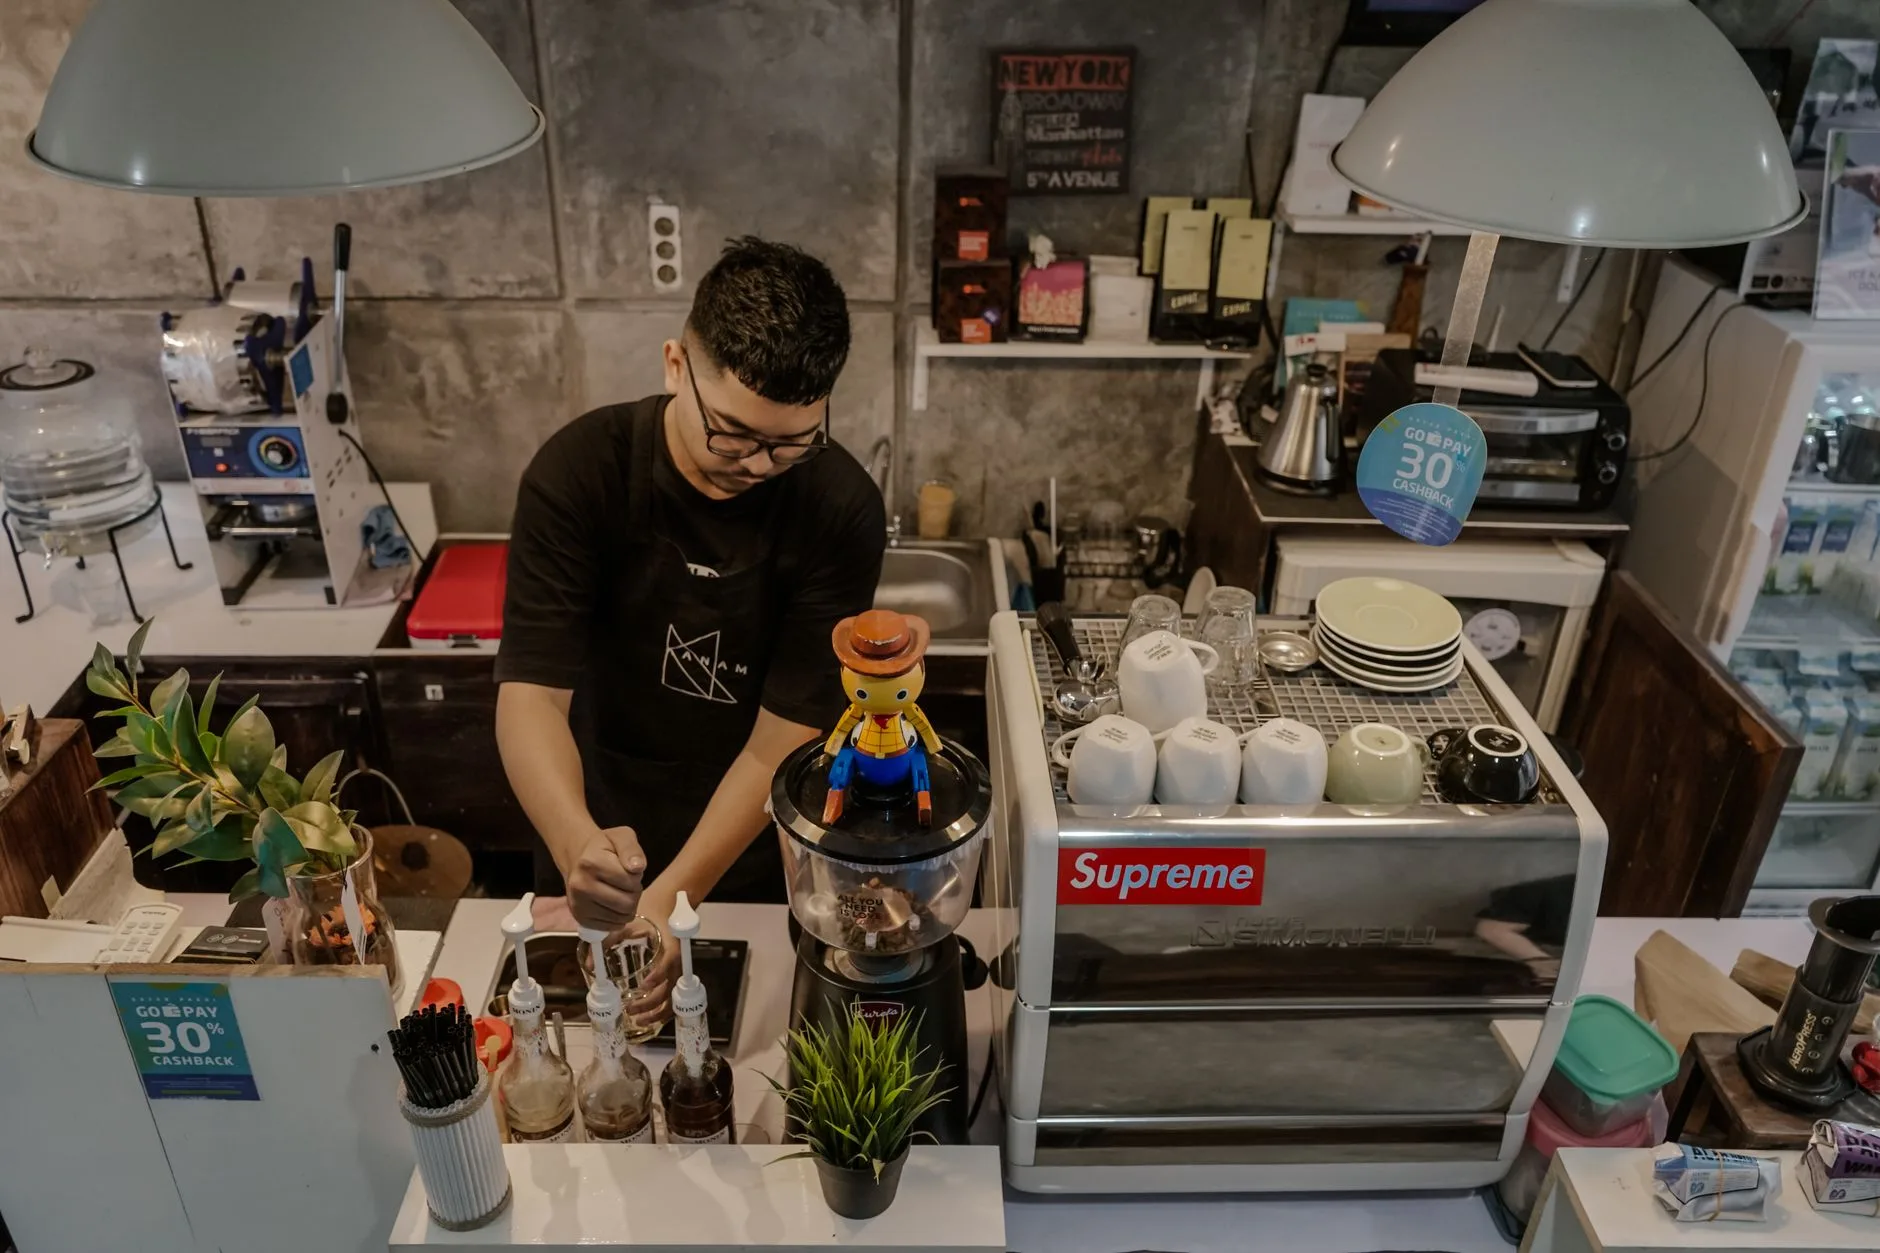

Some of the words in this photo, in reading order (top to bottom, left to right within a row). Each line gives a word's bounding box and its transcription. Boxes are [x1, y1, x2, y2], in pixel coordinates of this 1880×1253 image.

[1025, 126, 1125, 141] Manhattan
[1048, 170, 1120, 188] AVENUE
[1405, 427, 1425, 442] GO
[1442, 437, 1472, 458] PAY
[1393, 478, 1454, 509] CASHBACK
[1070, 852, 1254, 899] Supreme
[837, 895, 857, 904] ALL
[860, 898, 883, 906] YOU
[845, 903, 876, 912] NEED
[1233, 926, 1435, 948] SIMONELLI
[136, 1006, 161, 1018] GO
[183, 1006, 218, 1018] PAY
[511, 1004, 541, 1016] MONIN
[588, 1009, 613, 1018] ONIN
[675, 1004, 705, 1015] MONIN
[1788, 1012, 1817, 1070] AEROPRESS
[152, 1055, 235, 1066] CASHBACK
